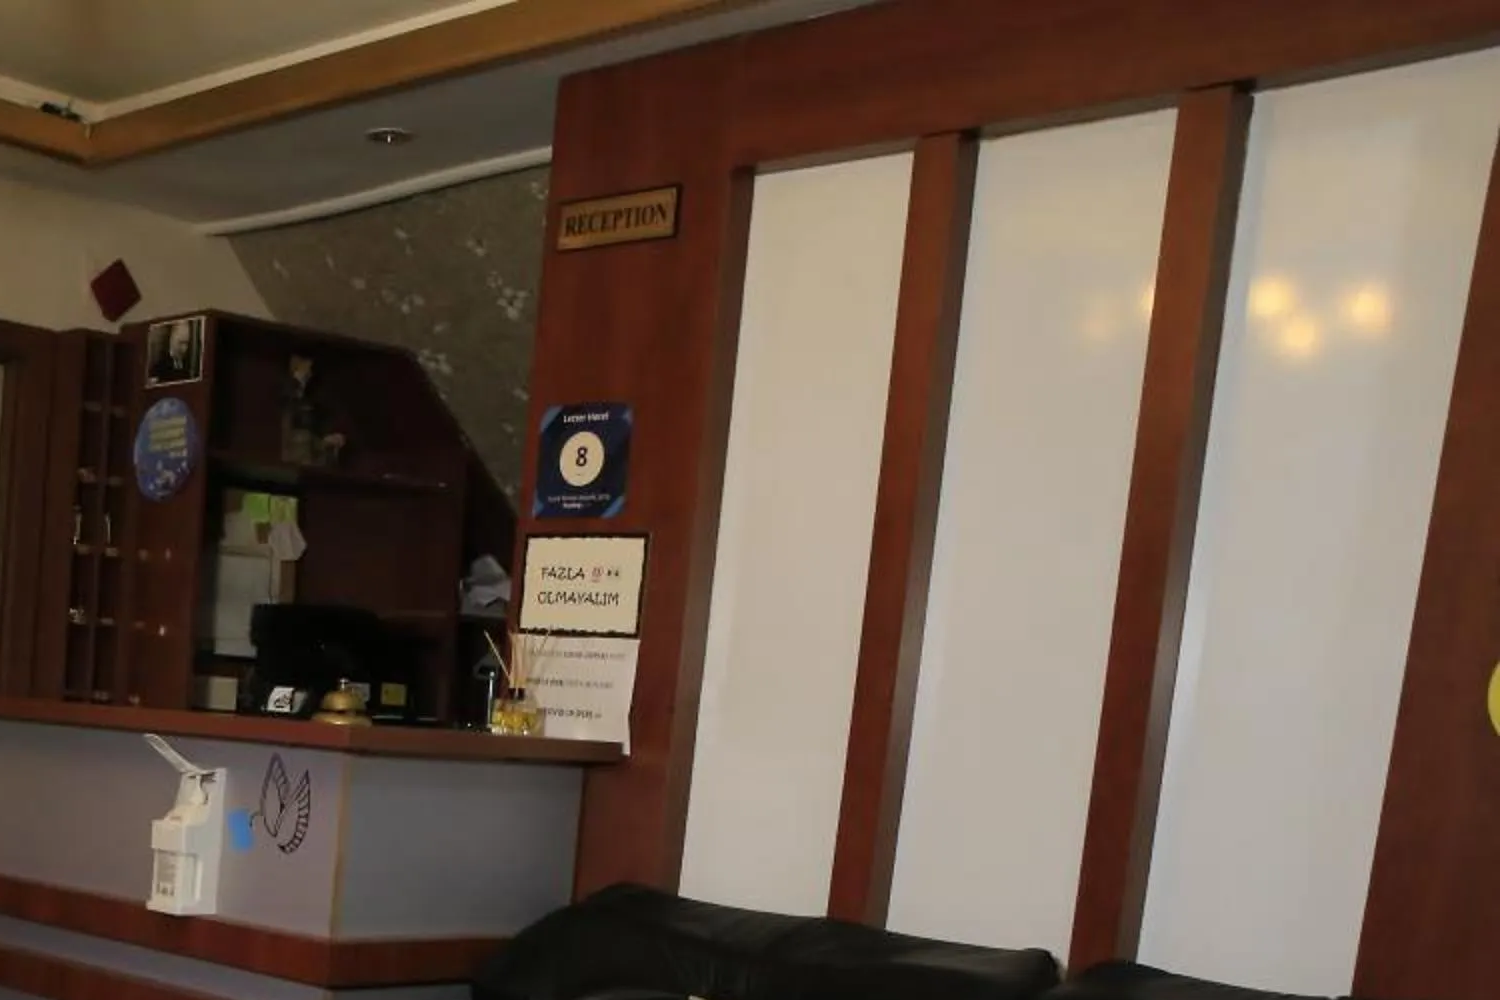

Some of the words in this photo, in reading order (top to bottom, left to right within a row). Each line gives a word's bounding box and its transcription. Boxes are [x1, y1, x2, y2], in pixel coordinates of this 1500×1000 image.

[564, 203, 667, 237] RECEPTION
[575, 446, 588, 467] 8
[541, 566, 585, 581] FAZLA
